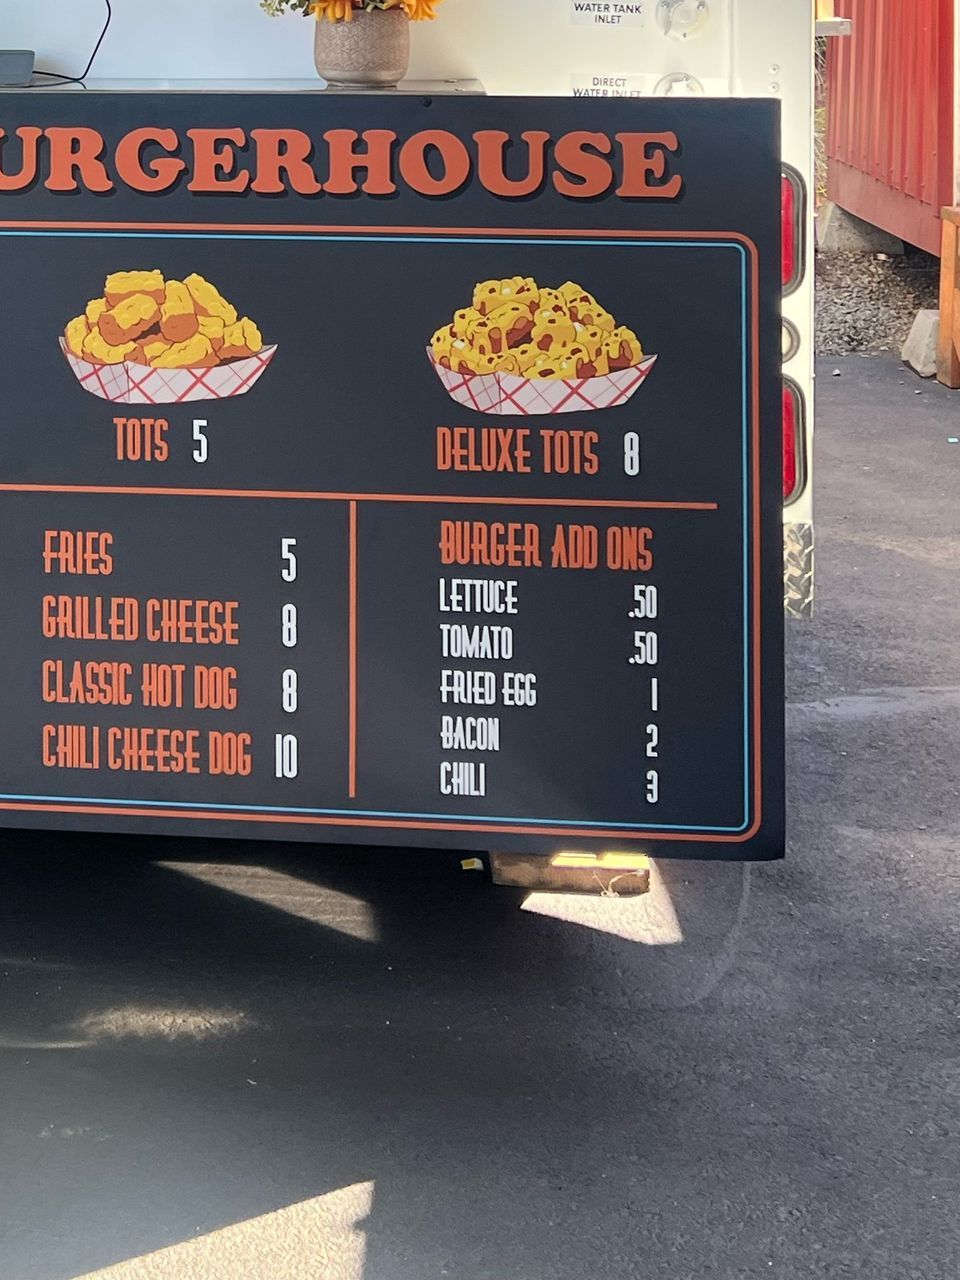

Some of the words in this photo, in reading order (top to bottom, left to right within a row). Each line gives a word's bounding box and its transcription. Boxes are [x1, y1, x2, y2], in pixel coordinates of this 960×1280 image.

[574, 2, 610, 13] WATER
[612, 3, 642, 14] TANK
[594, 14, 622, 24] INLET
[592, 77, 627, 88] DIRECT
[114, 417, 168, 461] TOTS
[193, 420, 207, 462] 5
[437, 427, 530, 472] DELUXE
[541, 429, 598, 474] TOTS
[624, 432, 639, 475] 8
[44, 530, 113, 575] FRIES
[282, 538, 296, 581] 5
[440, 520, 541, 566] BURGER
[553, 525, 598, 568] ADD
[607, 527, 652, 569] ONS
[440, 578, 517, 613] LETTUCE
[629, 585, 657, 618] .50
[43, 595, 139, 640] GRILLED
[147, 599, 238, 644] CHEESE
[283, 604, 296, 647] 8
[440, 624, 512, 659] TOMATO
[629, 631, 657, 664] .50
[44, 660, 132, 704] CLASSIC
[143, 664, 185, 706] HOT
[195, 665, 237, 708] DOG
[283, 669, 297, 712] 8
[440, 670, 495, 704] FRIED
[502, 672, 536, 706] EGG
[652, 678, 657, 710] 1
[43, 724, 100, 768] CHILI
[108, 727, 199, 773] CHEESE
[210, 731, 252, 775] DOG
[276, 734, 297, 778] 10
[441, 716, 499, 750] BACON
[647, 724, 657, 757] 2
[441, 762, 485, 796] CHILI
[647, 770, 658, 803] 3
